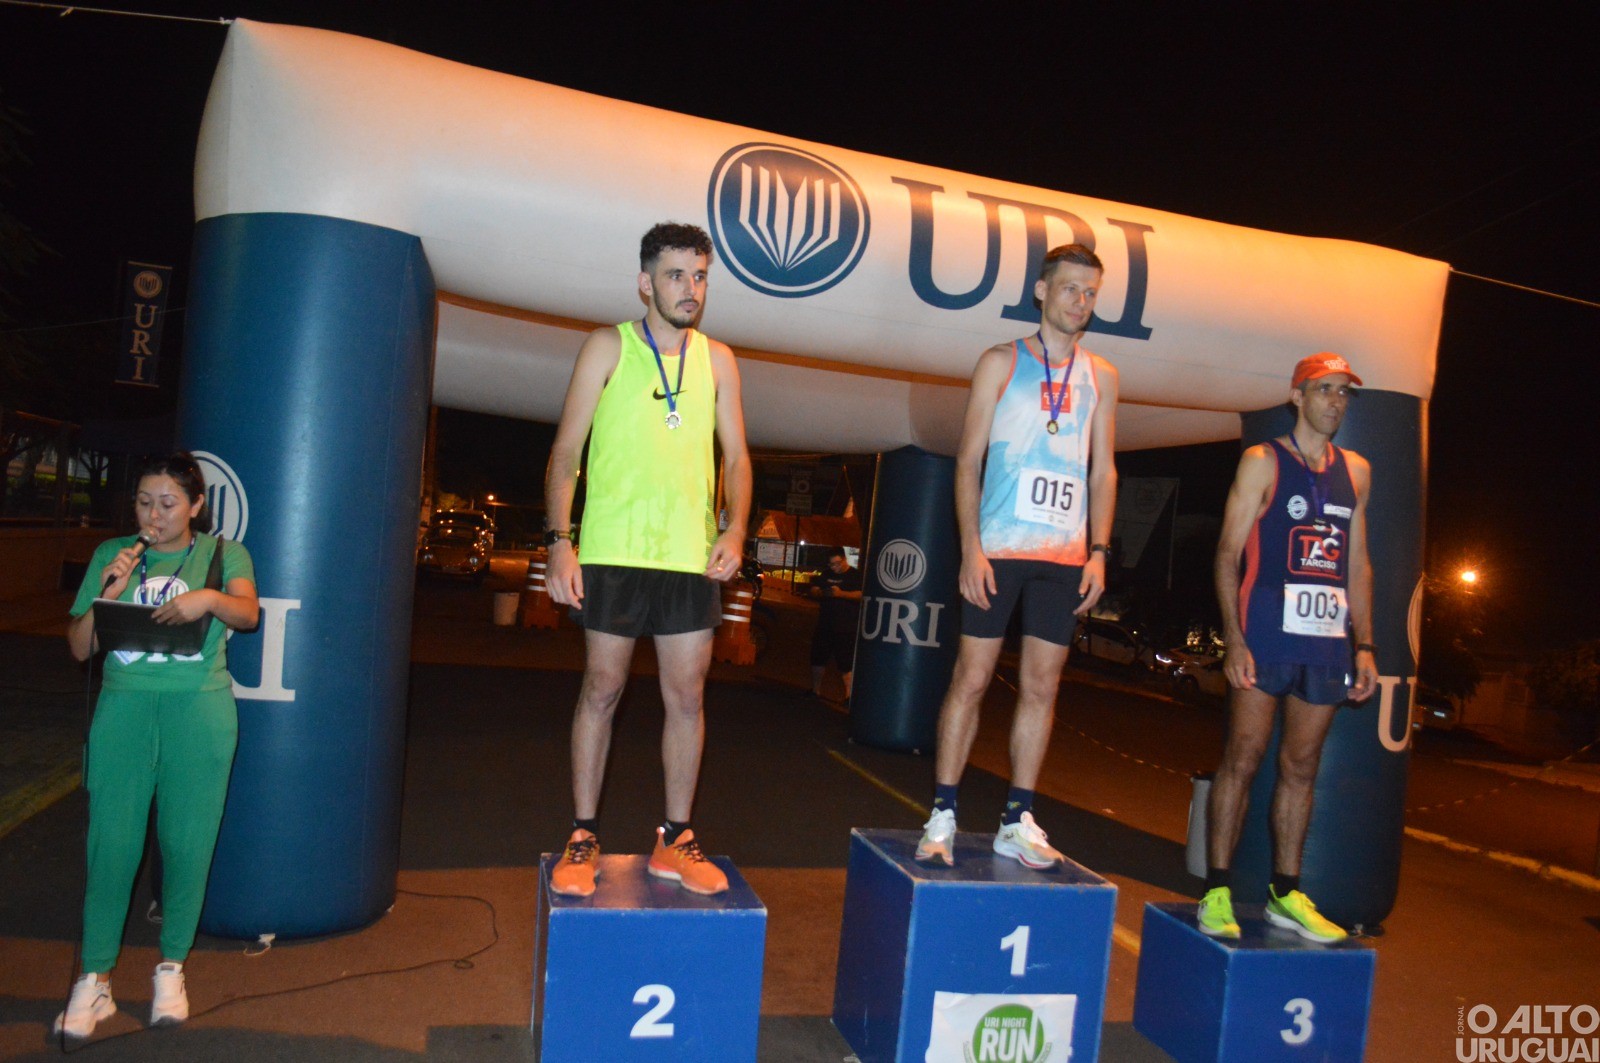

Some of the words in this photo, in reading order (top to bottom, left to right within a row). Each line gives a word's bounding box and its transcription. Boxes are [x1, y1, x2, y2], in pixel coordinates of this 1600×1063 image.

[891, 176, 1154, 340] URI
[129, 303, 158, 380] URI
[1031, 476, 1074, 511] 015
[1299, 535, 1340, 562] TAG
[1300, 557, 1336, 570] TARCISO
[861, 596, 945, 648] URI
[1296, 590, 1339, 620] 003
[1000, 925, 1030, 976] 1
[629, 983, 675, 1038] 2
[984, 1017, 1000, 1028] URI
[1001, 1017, 1028, 1028] NIGHT
[1280, 997, 1314, 1045] 3
[978, 1025, 1038, 1062] RUN
